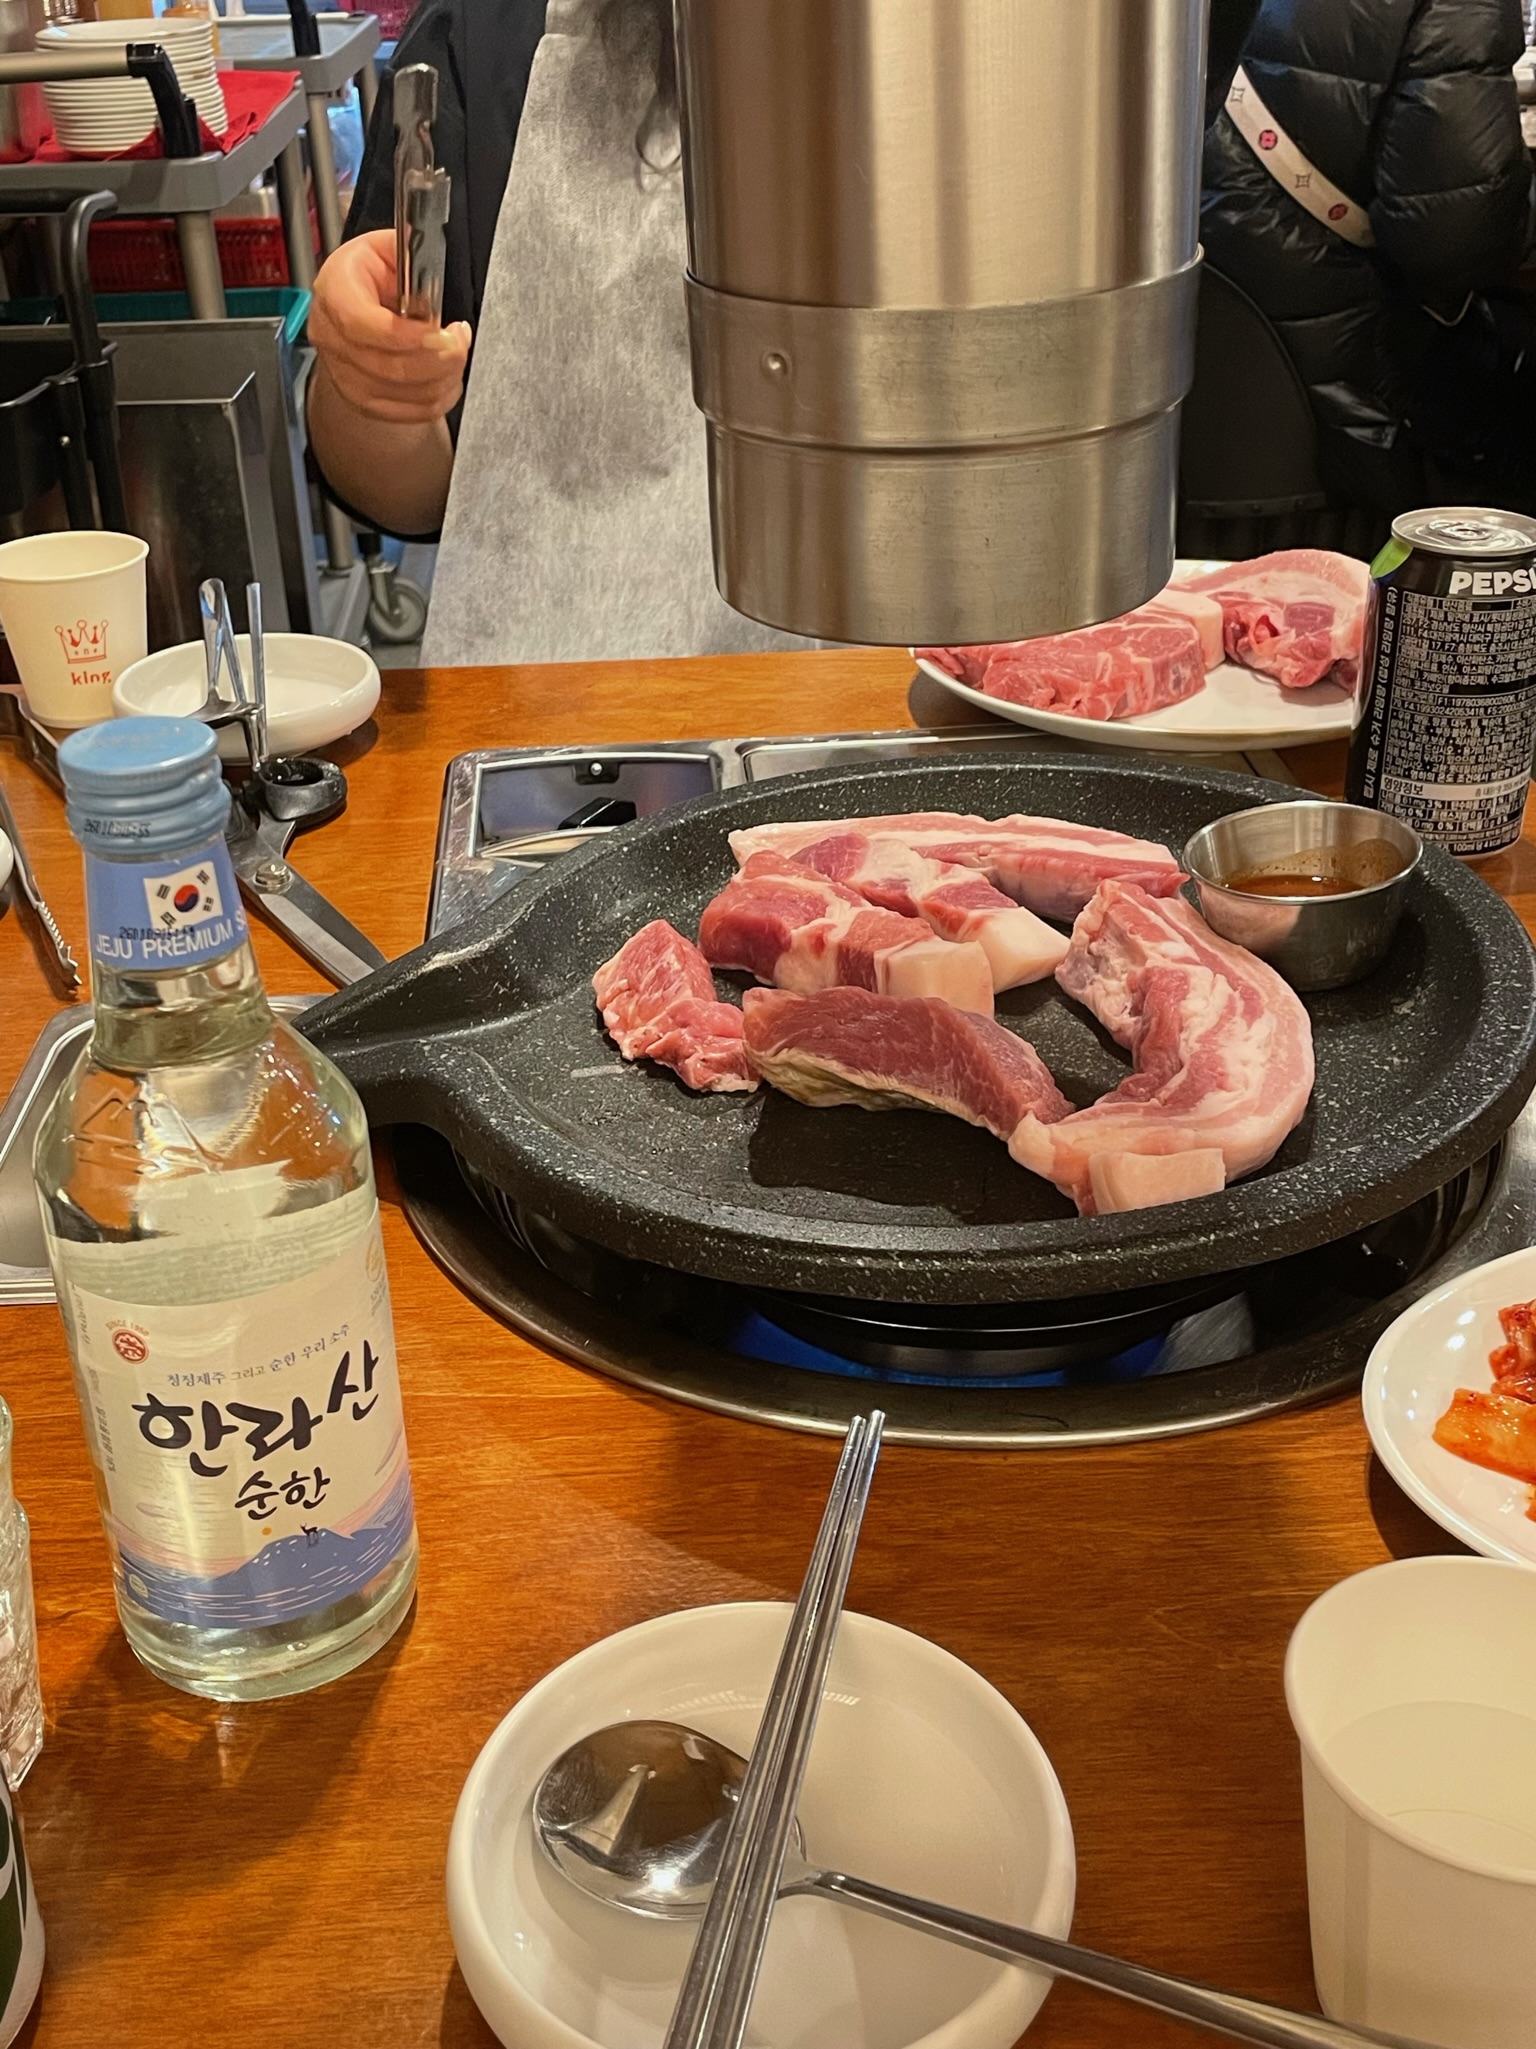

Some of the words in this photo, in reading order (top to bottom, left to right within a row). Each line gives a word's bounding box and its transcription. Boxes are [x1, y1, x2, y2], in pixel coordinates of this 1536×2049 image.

[1381, 617, 1394, 654] 라임향
[1373, 684, 1386, 720] 라임향
[1370, 720, 1382, 746] 슈거
[1384, 777, 1424, 796] 영양정보
[96, 934, 133, 959] JEJU
[142, 919, 234, 959] PREMIUM
[167, 1371, 226, 1387] 청정제주
[231, 1365, 266, 1381] 그리고
[269, 1352, 297, 1372] 순한
[301, 1338, 326, 1360] 우리
[329, 1324, 350, 1345] 소주
[131, 1339, 380, 1477] 한라산
[234, 1466, 332, 1520] 순한
